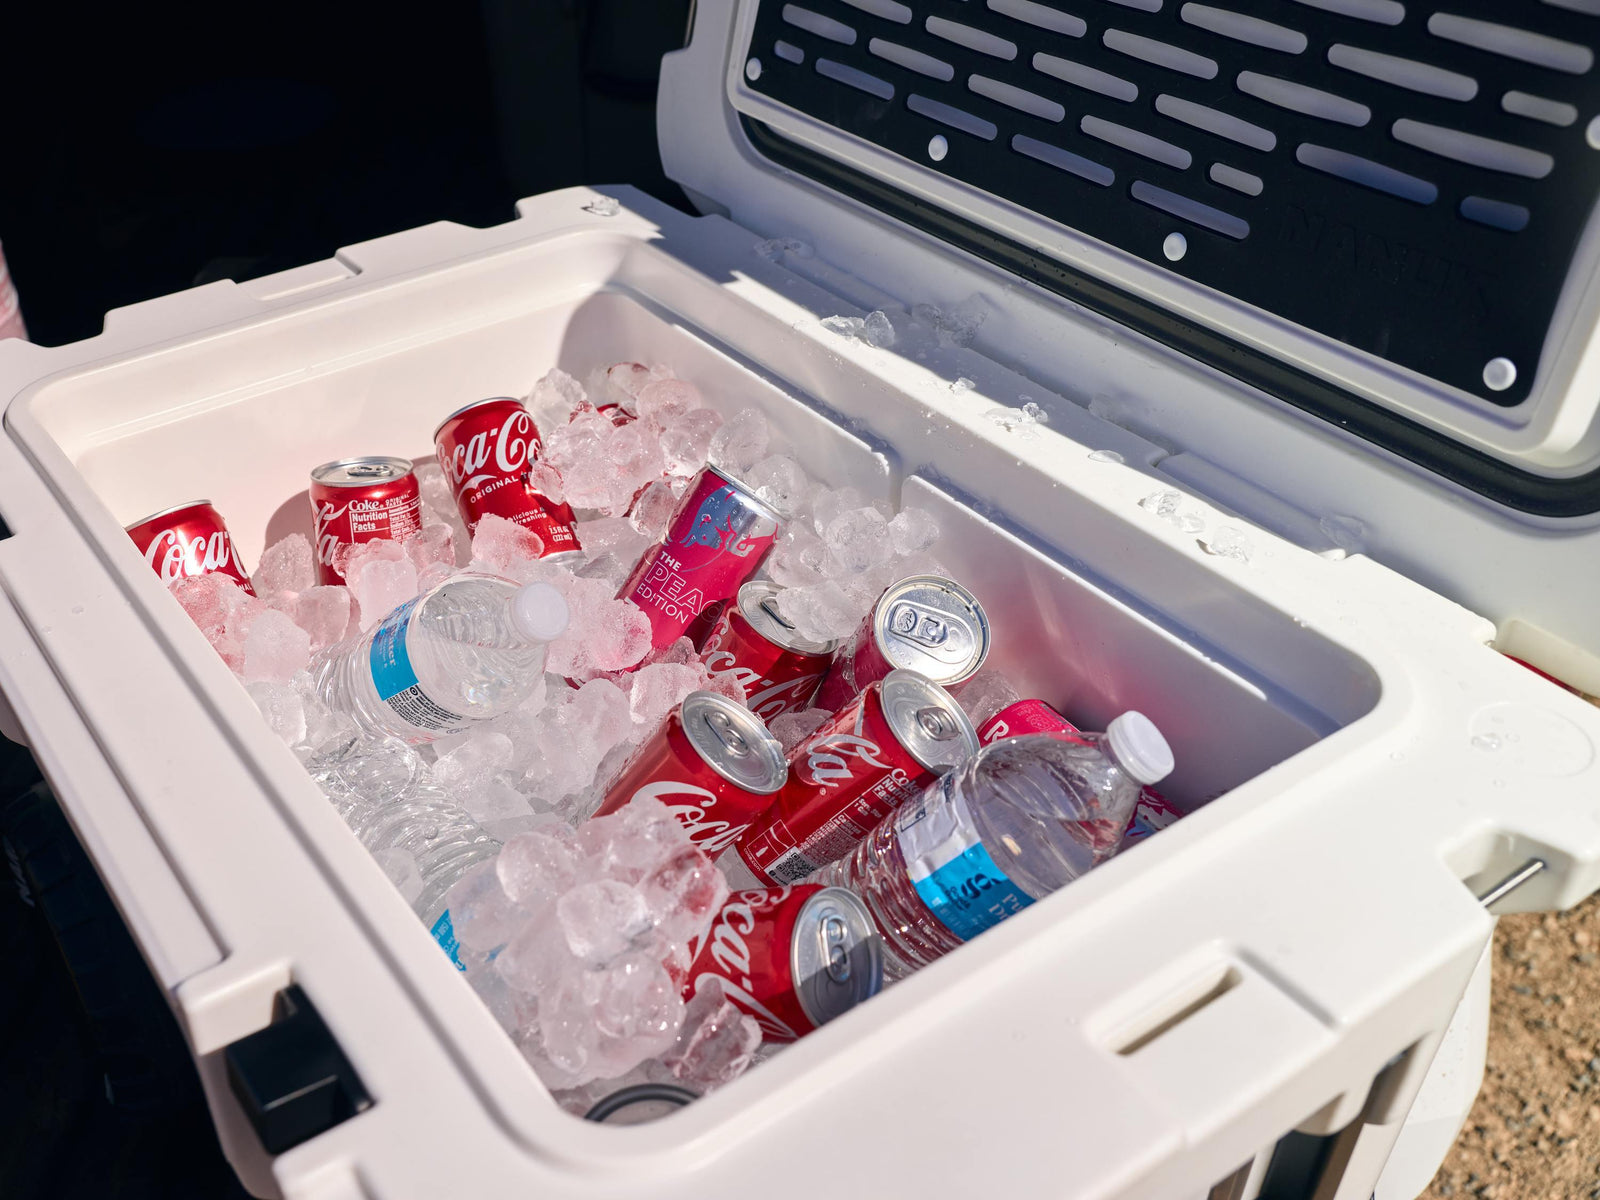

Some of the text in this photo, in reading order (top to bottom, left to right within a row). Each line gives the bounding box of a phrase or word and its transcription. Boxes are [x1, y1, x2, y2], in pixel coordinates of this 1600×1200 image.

[469, 475, 519, 504] ORIGINAL
[348, 500, 379, 511] Coke
[352, 511, 388, 522] Nutrition
[512, 508, 538, 521] licious
[353, 522, 376, 531] Facts
[658, 550, 682, 572] THE
[644, 561, 722, 623] PEAC
[636, 583, 689, 624] EDITION
[873, 784, 899, 807] Facts
[742, 848, 762, 871] coke.com
